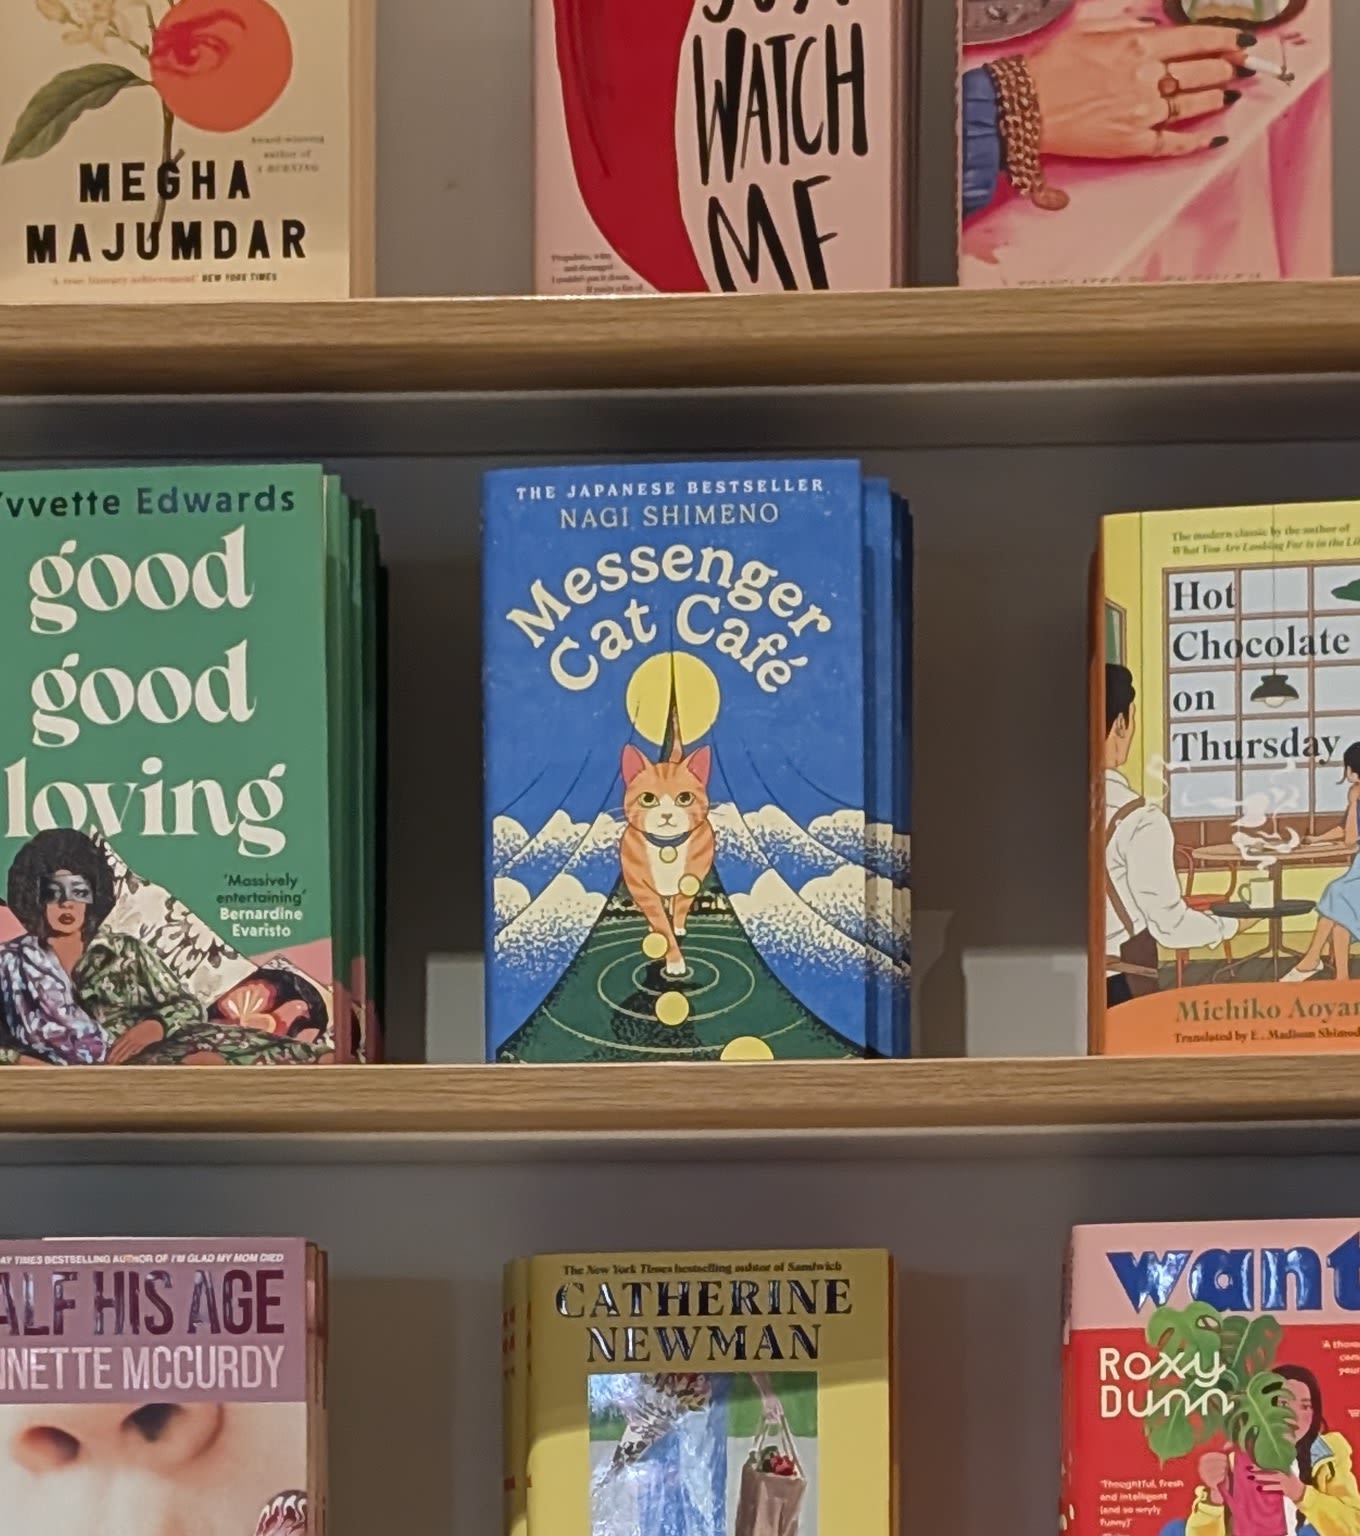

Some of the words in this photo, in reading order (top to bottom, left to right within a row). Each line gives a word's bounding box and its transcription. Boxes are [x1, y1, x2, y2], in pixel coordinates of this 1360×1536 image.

[692, 22, 870, 186] WATCH
[79, 160, 251, 203] MEGHA
[25, 220, 306, 264] MAJUMDAR
[137, 485, 295, 514] Edwards
[516, 486, 556, 500] THE
[566, 482, 675, 497] JAPANESE
[687, 478, 824, 494] BESTSELLER
[560, 508, 629, 529] NAGI
[644, 504, 780, 526] SHIMENO
[29, 525, 254, 635] good
[506, 544, 831, 648] Messenger
[1173, 580, 1237, 612] Hot
[549, 598, 658, 692] Cat
[675, 594, 808, 693] Café
[1173, 627, 1351, 661] Chocolate
[31, 639, 256, 748] good
[1173, 686, 1215, 713] on
[1173, 728, 1341, 766] Thursday
[4, 757, 286, 858] loving
[219, 907, 303, 922] Bernardine
[232, 923, 292, 938] Evaristo
[1176, 997, 1281, 1024] Michiko
[93, 1270, 174, 1336] HIS
[187, 1270, 284, 1334] AGE
[556, 1279, 852, 1318] CATHERINE
[588, 1325, 821, 1362] NEWMAN
[122, 1345, 284, 1390] MCCURDY
[1099, 1347, 1227, 1386] Roxy
